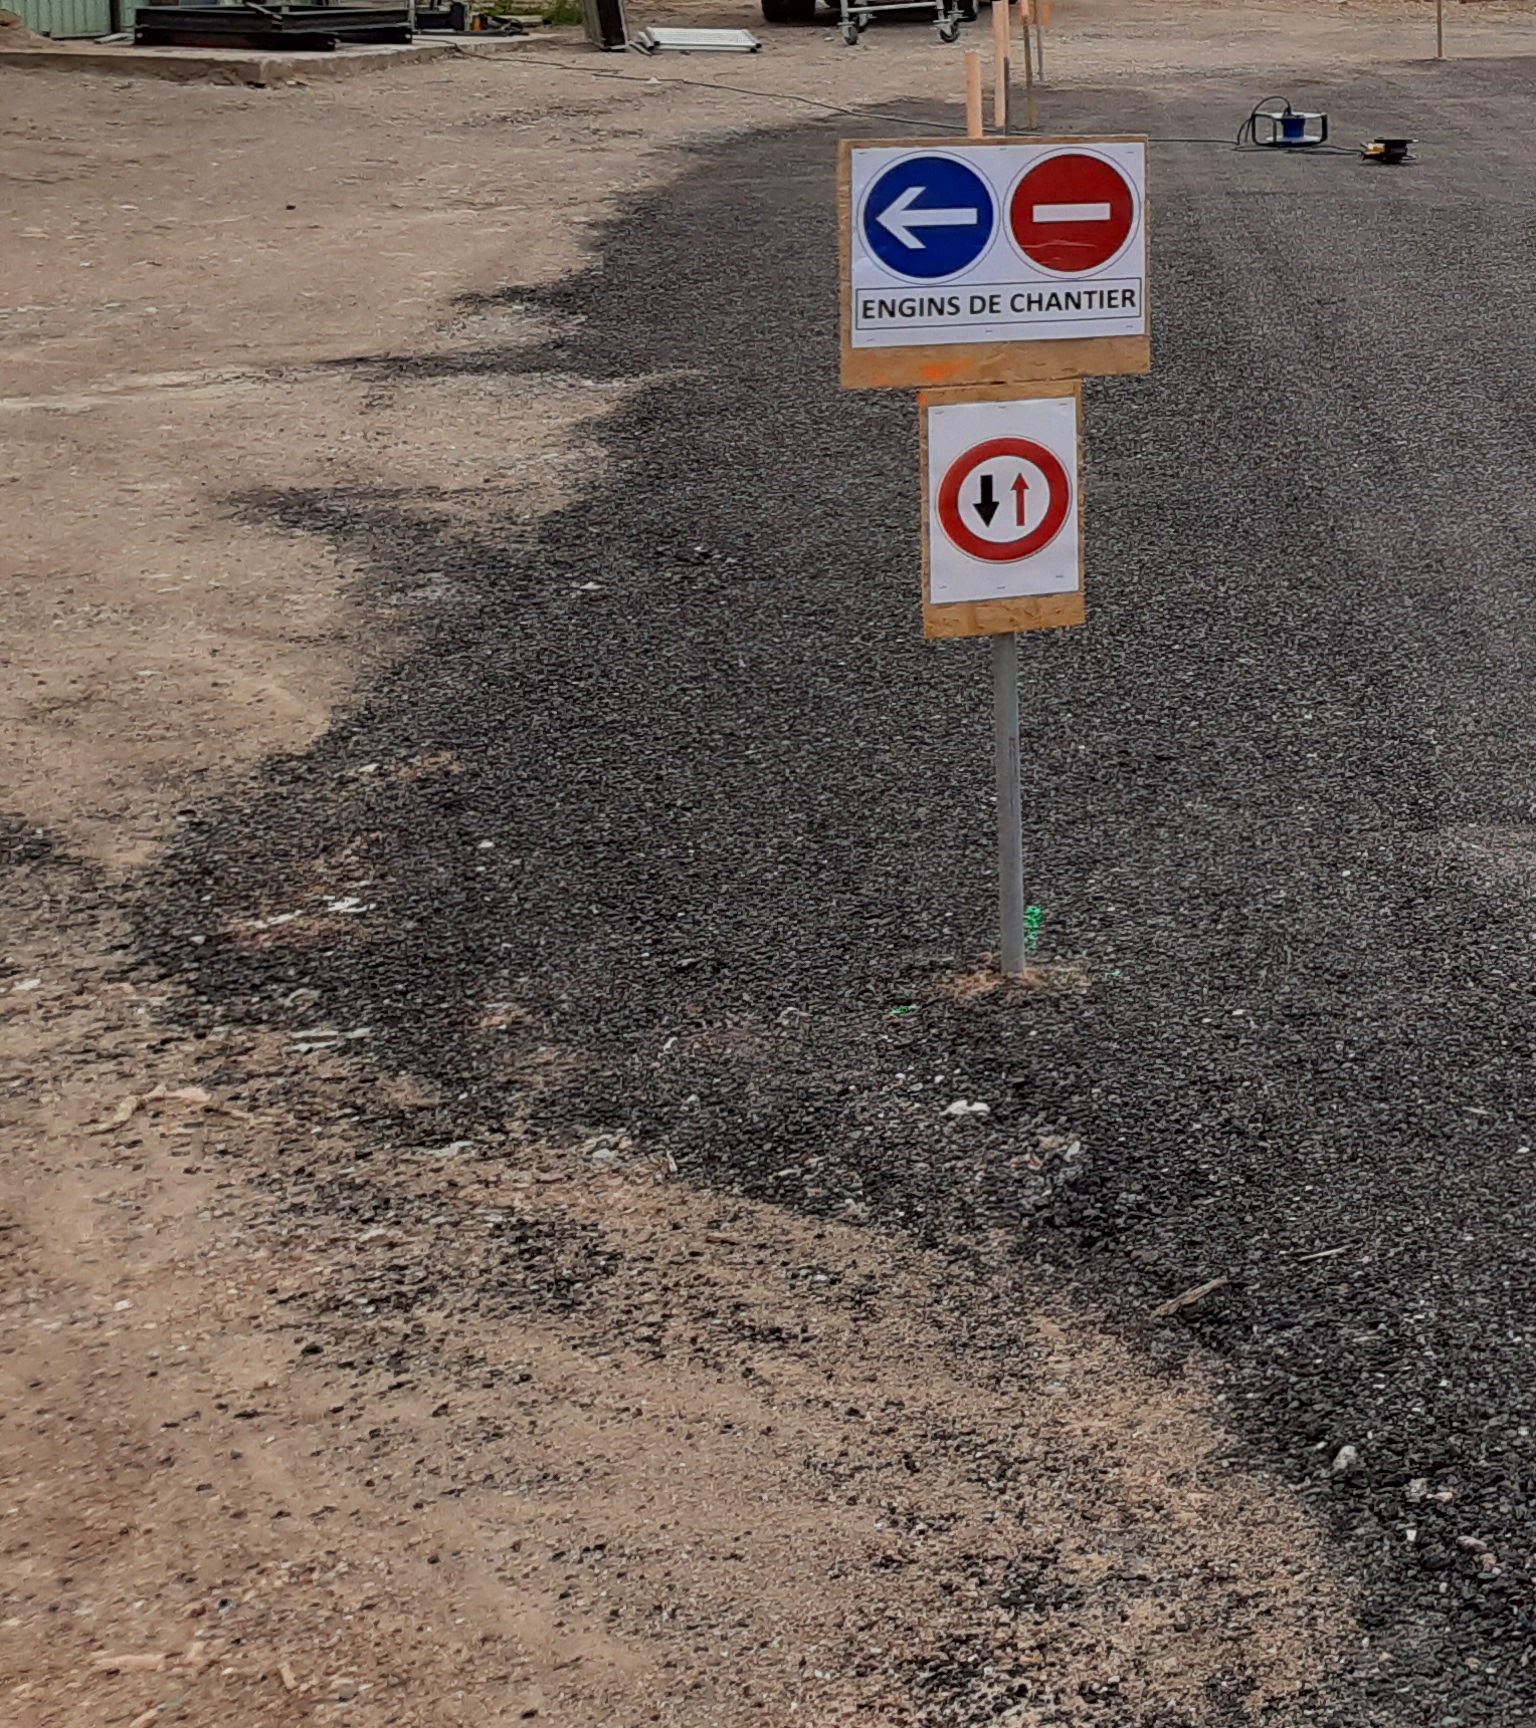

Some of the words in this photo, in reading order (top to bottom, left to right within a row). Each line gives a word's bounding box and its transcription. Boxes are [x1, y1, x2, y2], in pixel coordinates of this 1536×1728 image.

[861, 295, 961, 320] ENGINS
[969, 292, 1001, 315] DE
[1010, 288, 1136, 314] CHANTIER
